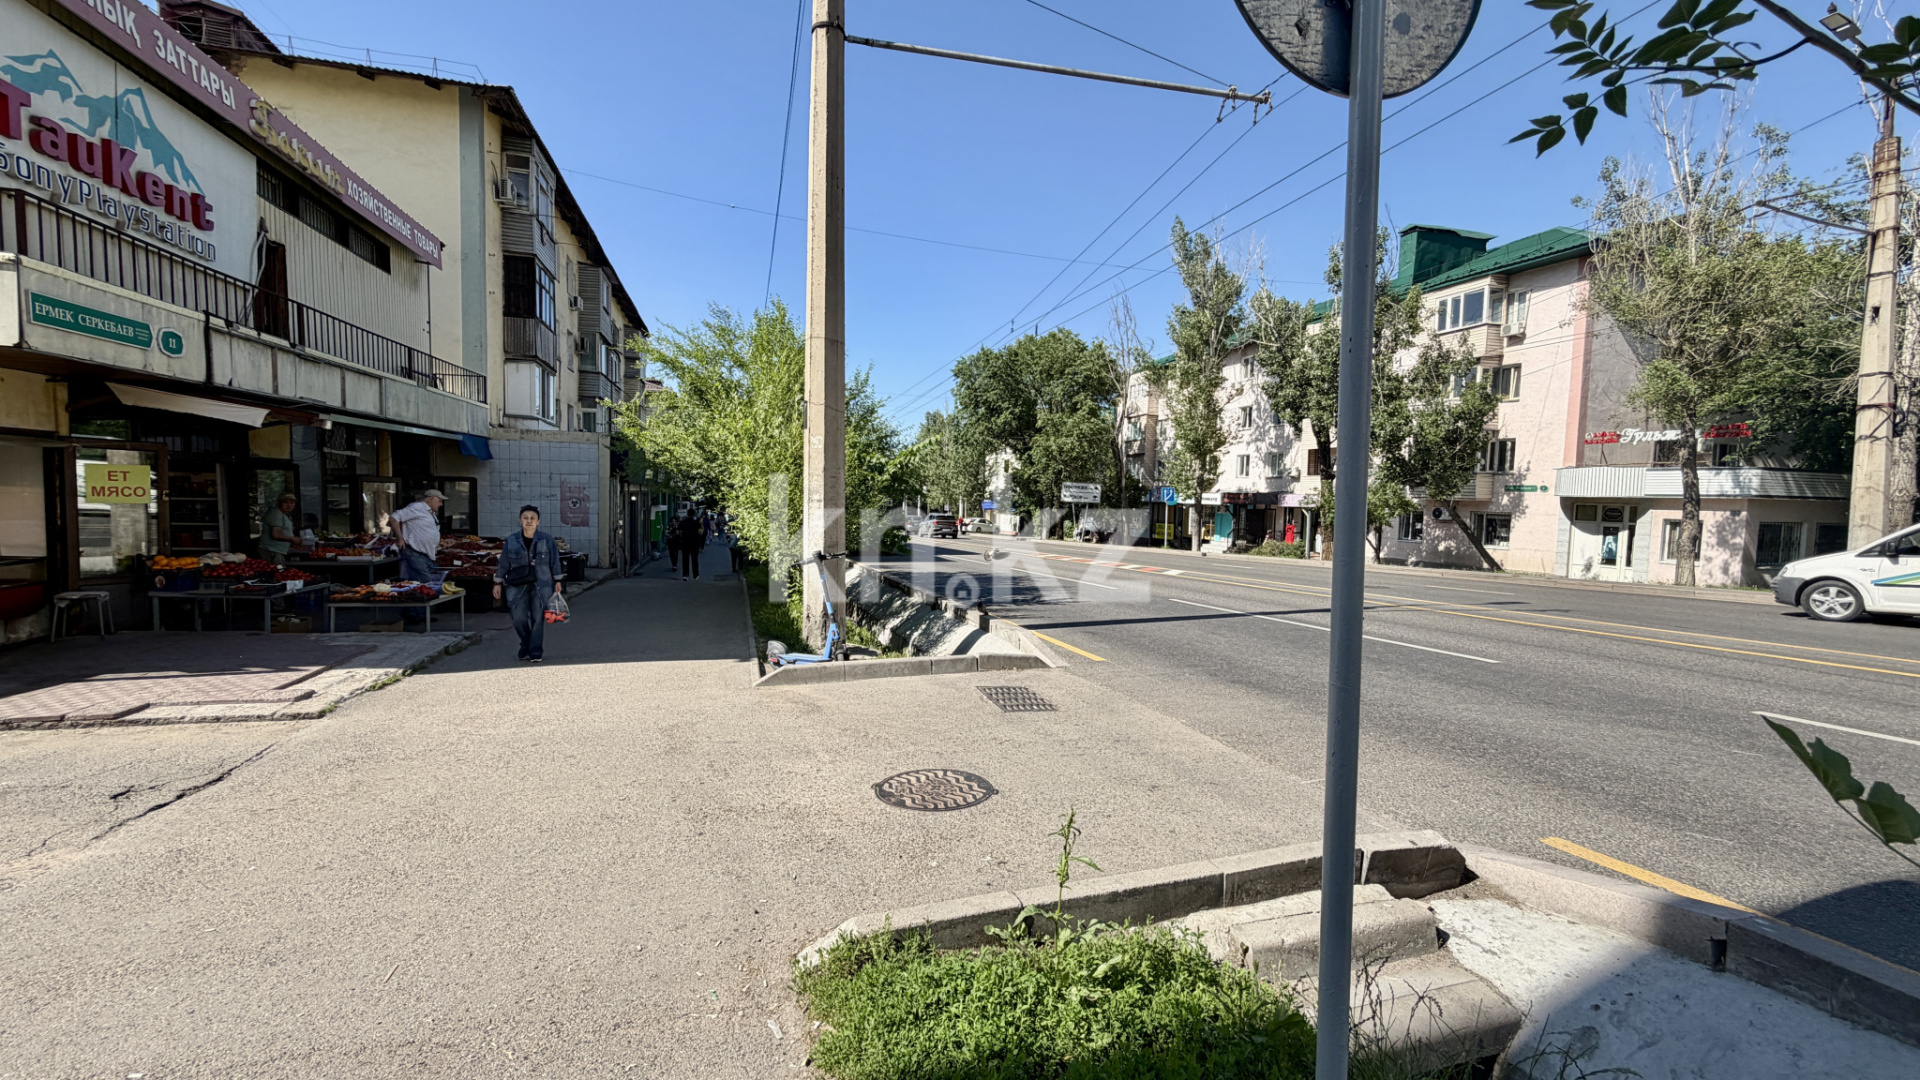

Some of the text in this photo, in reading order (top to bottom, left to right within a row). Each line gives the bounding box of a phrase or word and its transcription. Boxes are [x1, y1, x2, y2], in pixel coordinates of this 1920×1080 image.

[153, 29, 236, 111] ЗАТТАРЫ
[346, 177, 412, 241] ХОЗЯЙСТВЕННЫЕ
[413, 229, 439, 260] ТОВАРЫ
[0, 78, 215, 232] TauKent
[34, 302, 75, 323] ЕРМЕК
[78, 313, 134, 337] СЕРКЕБАЕВ
[168, 337, 177, 349] 11
[1619, 427, 1704, 445] Гульж
[107, 470, 131, 482] ЕТ
[91, 486, 147, 497] МЯСО
